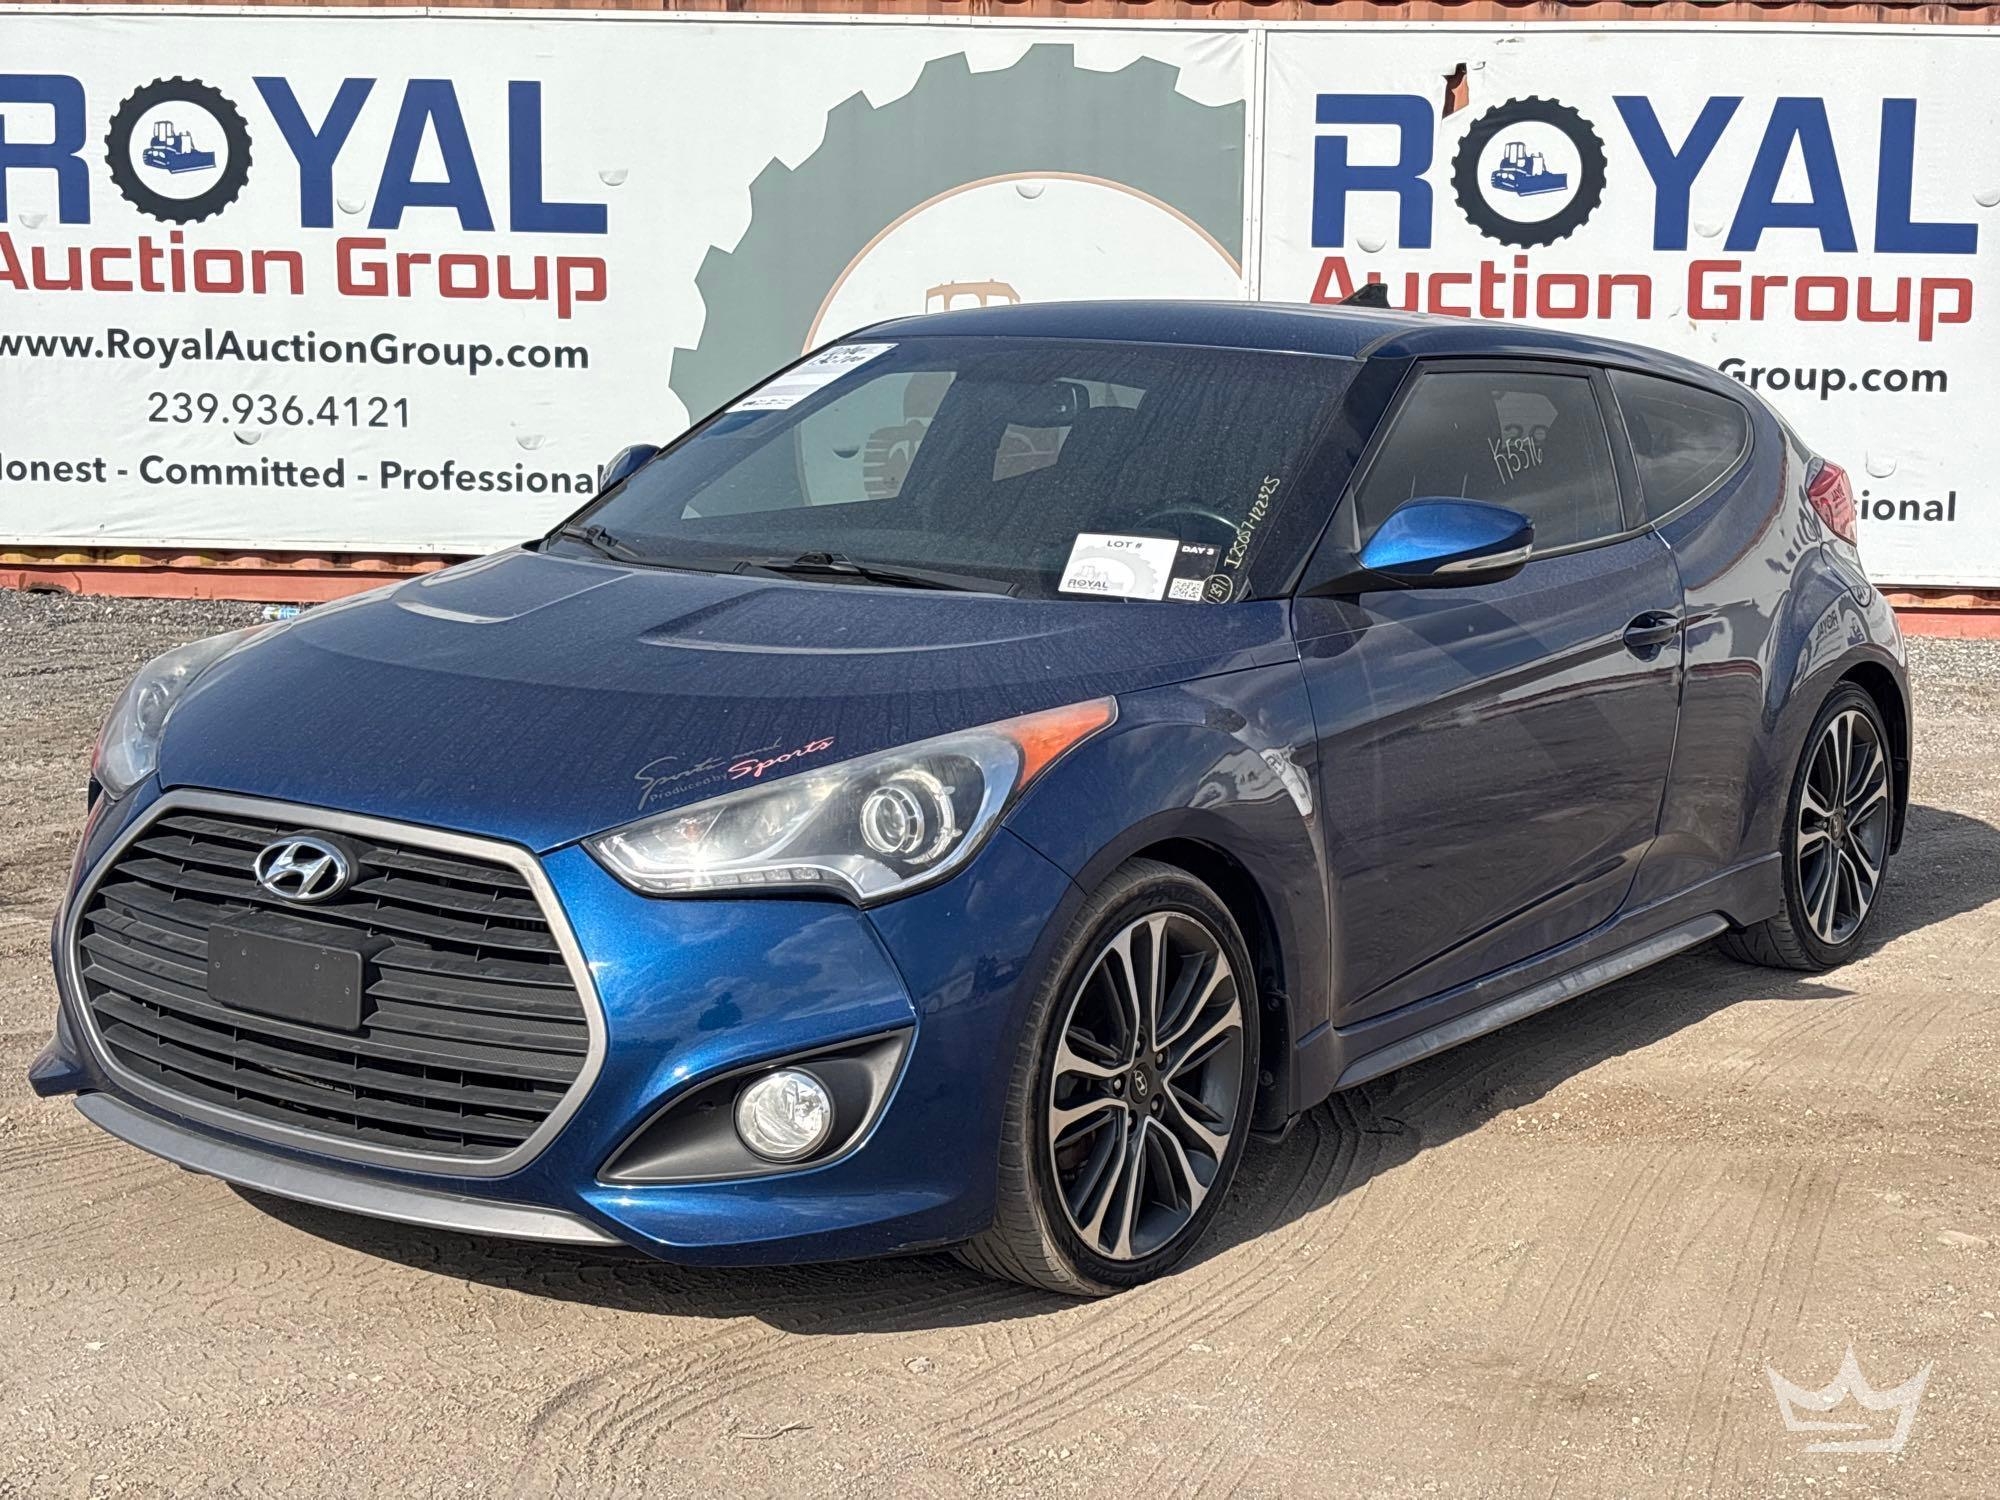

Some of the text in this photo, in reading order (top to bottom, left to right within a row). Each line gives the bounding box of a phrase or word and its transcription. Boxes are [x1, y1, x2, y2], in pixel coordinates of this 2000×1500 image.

[1311, 94, 1978, 254] ROYAL
[336, 237, 607, 318] Group
[1310, 255, 1973, 341] Auction Group
[0, 328, 589, 375] www.RoyalAuctionGroup.com
[1717, 358, 1948, 400] Group.com
[148, 391, 408, 428] 239.936.4121
[0, 453, 107, 483] onest
[139, 455, 344, 487] Committed
[380, 459, 605, 494] Professional
[1107, 540, 1132, 549] LOT
[1182, 545, 1206, 554] DAY
[1067, 579, 1110, 589] ROYAL
[727, 736, 835, 780] Sports
